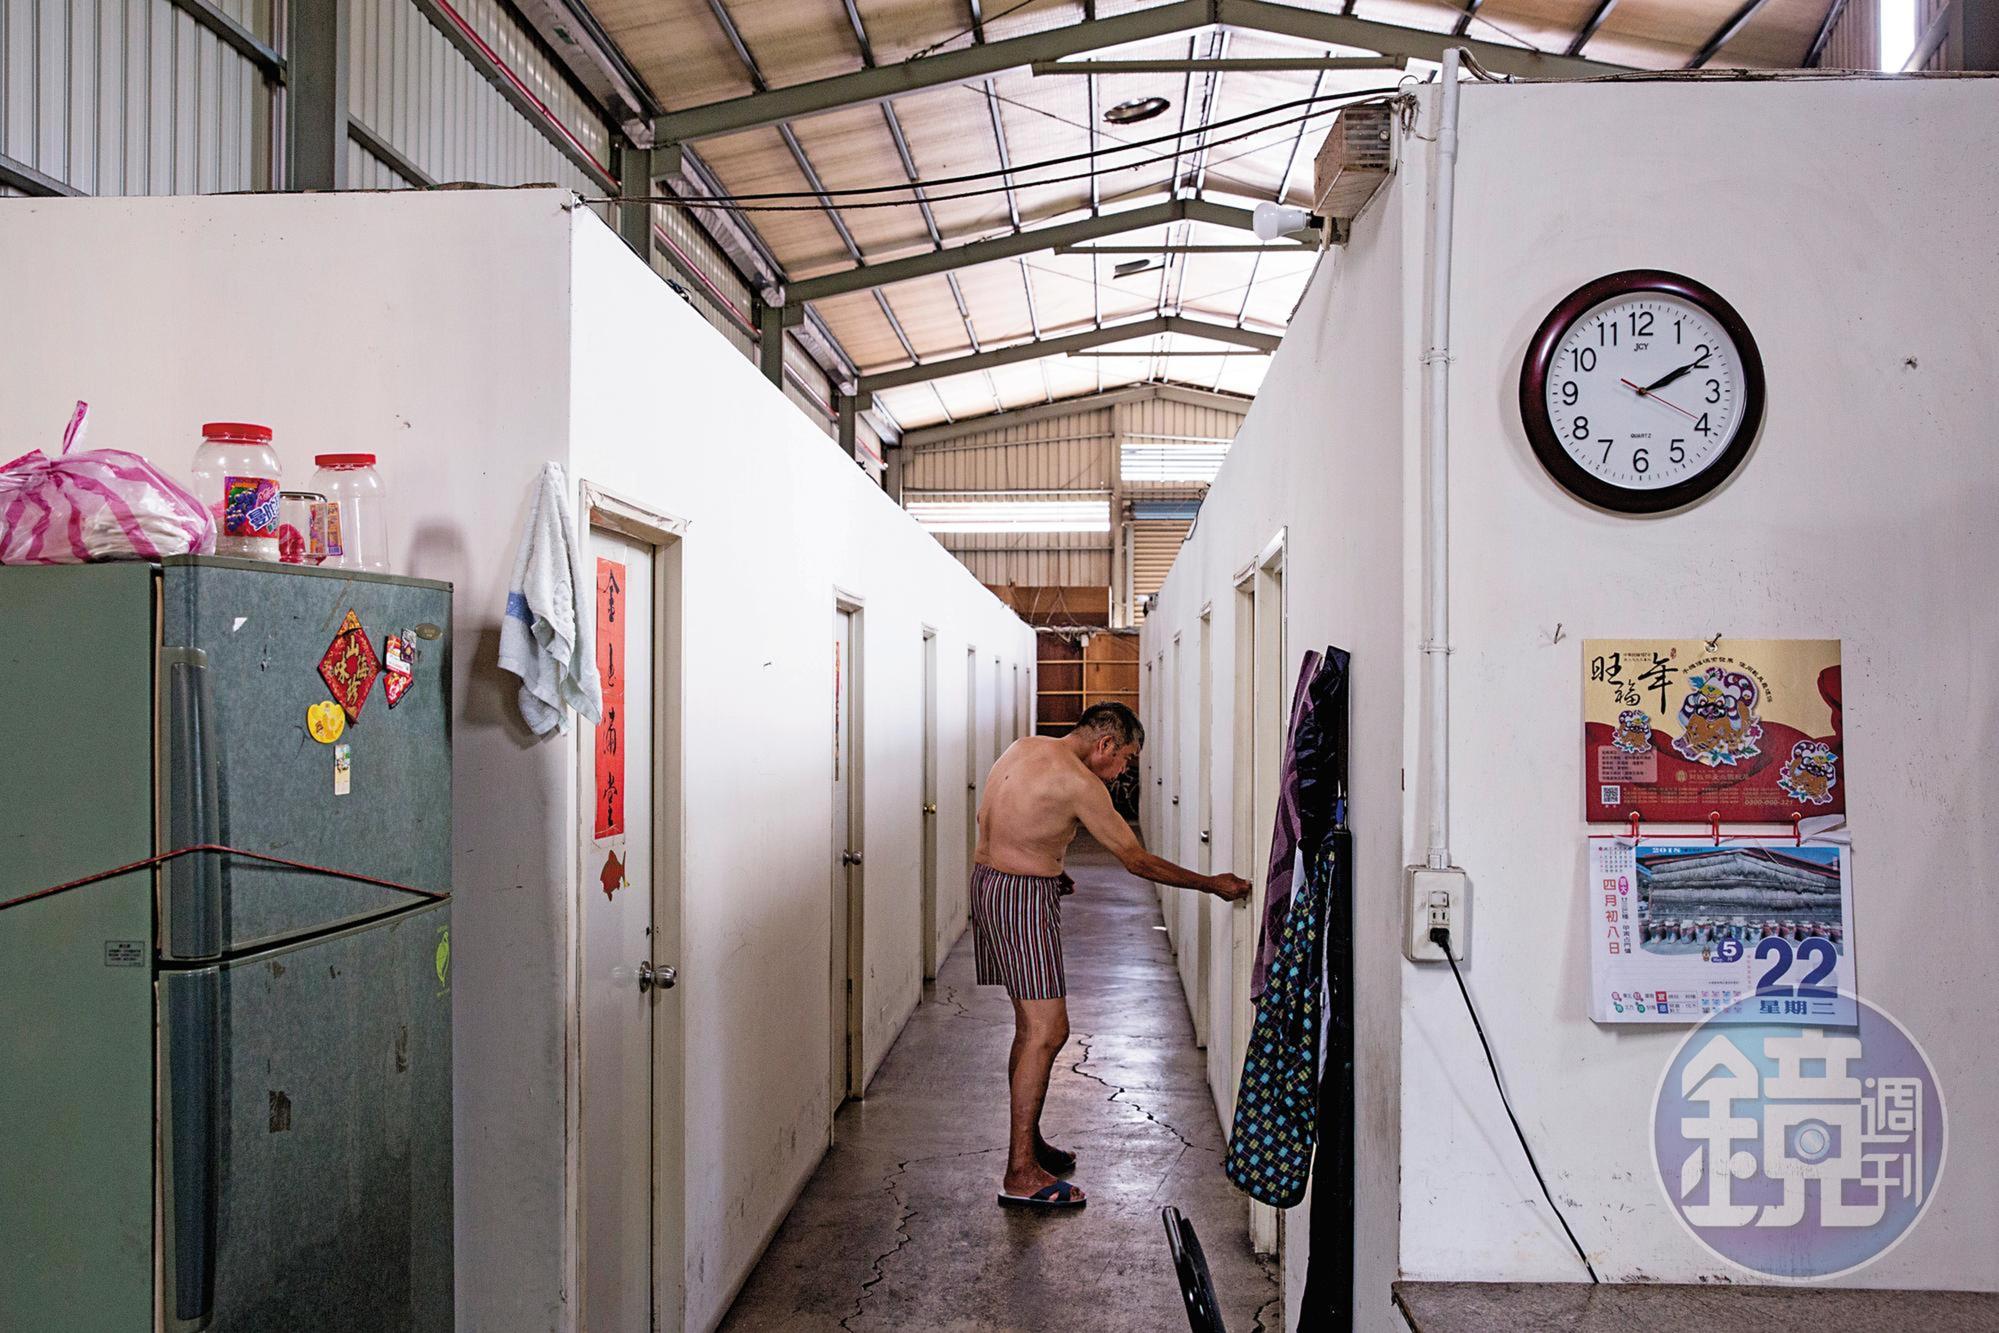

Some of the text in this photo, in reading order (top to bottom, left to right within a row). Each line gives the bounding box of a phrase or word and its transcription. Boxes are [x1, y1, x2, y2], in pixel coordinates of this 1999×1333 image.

[1597, 321, 1617, 347] 11
[1628, 311, 1654, 336] 12
[1673, 319, 1681, 345] 1
[1571, 347, 1597, 372] 10
[1693, 344, 1710, 369] 2
[1562, 381, 1578, 406] 9
[1705, 379, 1721, 404] 3
[1572, 416, 1589, 440] 8
[1694, 412, 1711, 437] 4
[1598, 439, 1614, 464] 7
[1632, 448, 1649, 473] 6
[1669, 438, 1685, 464] 5
[1602, 878, 1621, 955] 四月初八日
[1722, 941, 1737, 957] 5
[1754, 936, 1839, 999] 22
[1758, 999, 1836, 1016] 星期二
